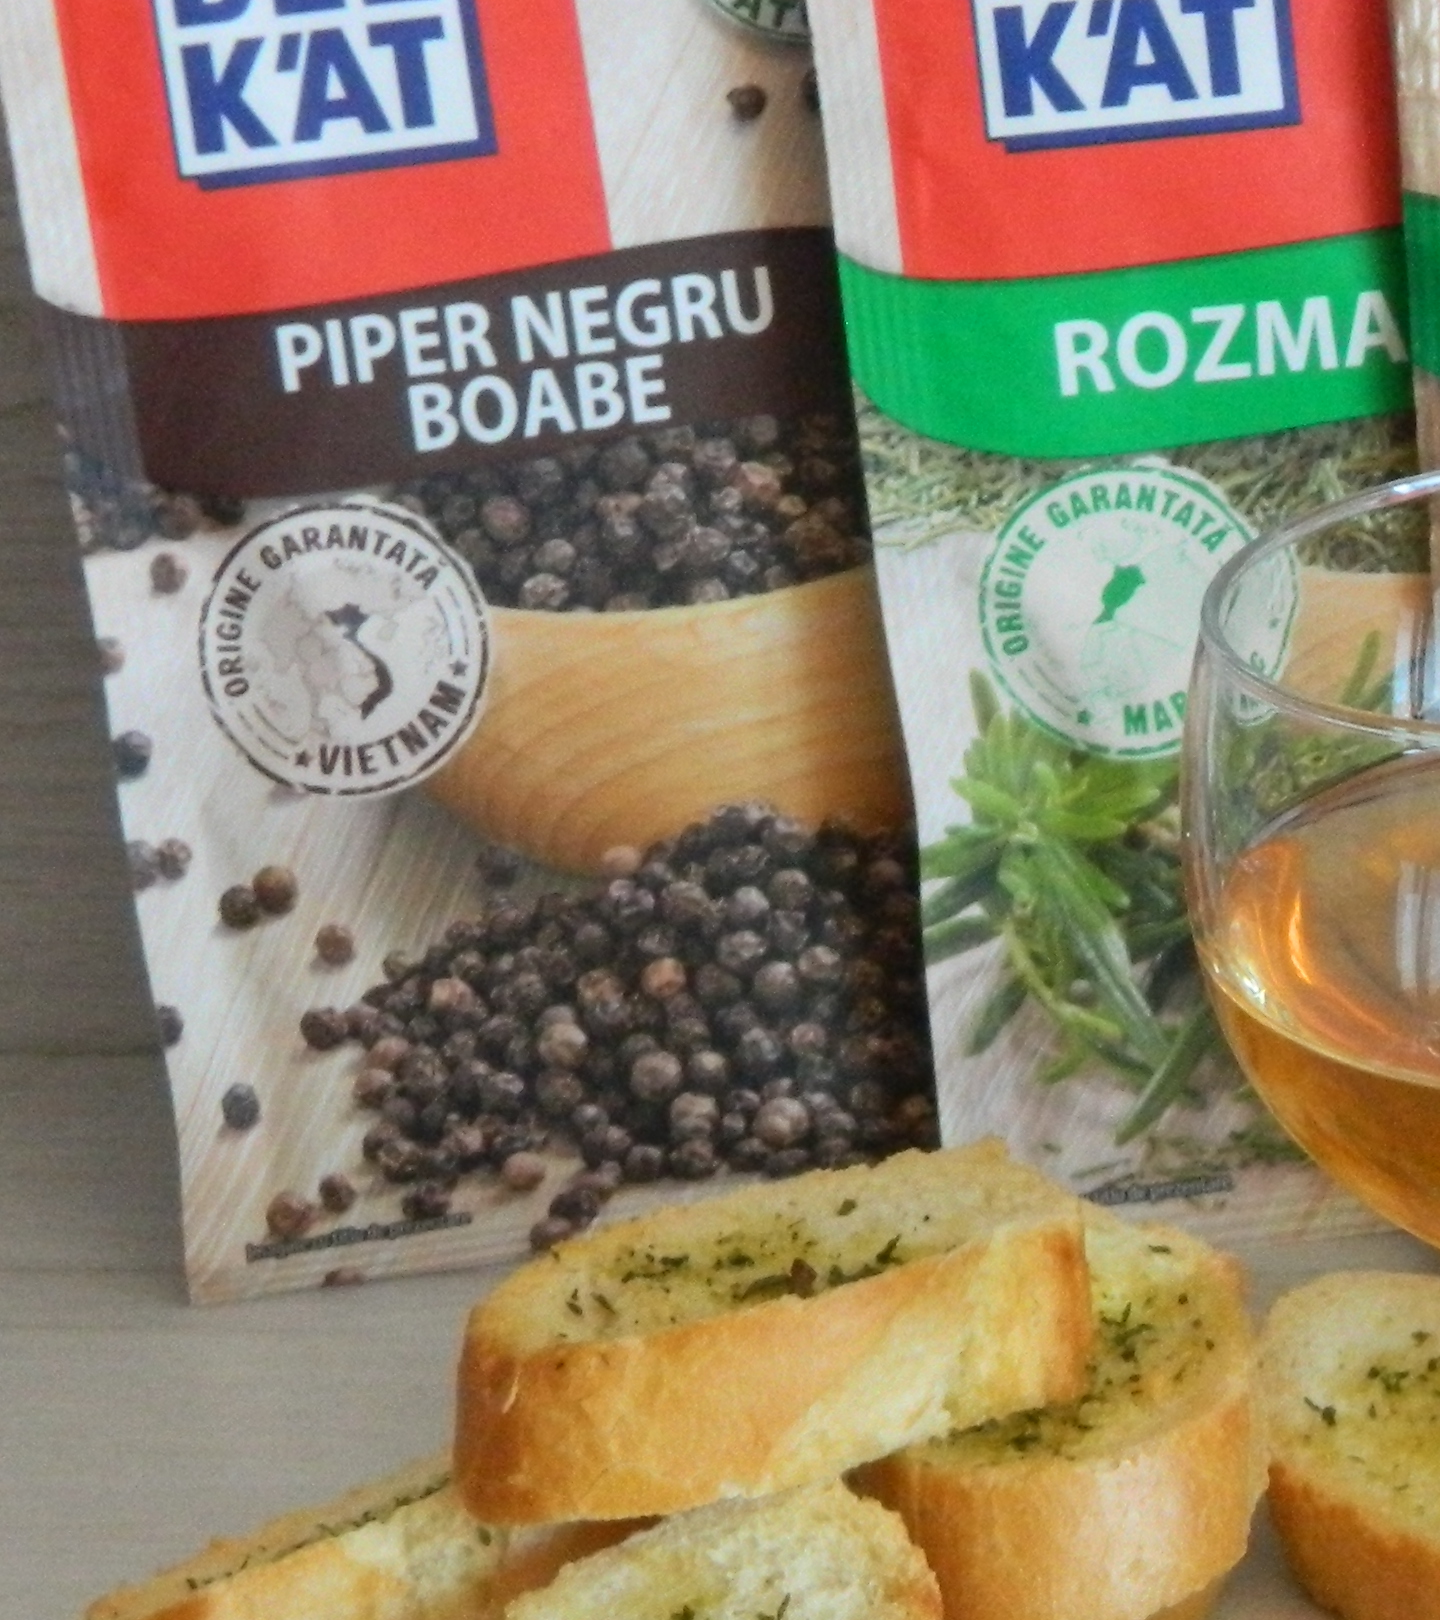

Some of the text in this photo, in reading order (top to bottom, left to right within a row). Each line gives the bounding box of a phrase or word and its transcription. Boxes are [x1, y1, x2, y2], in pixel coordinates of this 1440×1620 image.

[275, 265, 775, 394] PIPER NEGRU
[407, 354, 672, 454] BOABE
[216, 567, 262, 698] ORIGINE
[995, 525, 1047, 656] ORIGINE
[318, 679, 466, 776] VIETNAM
